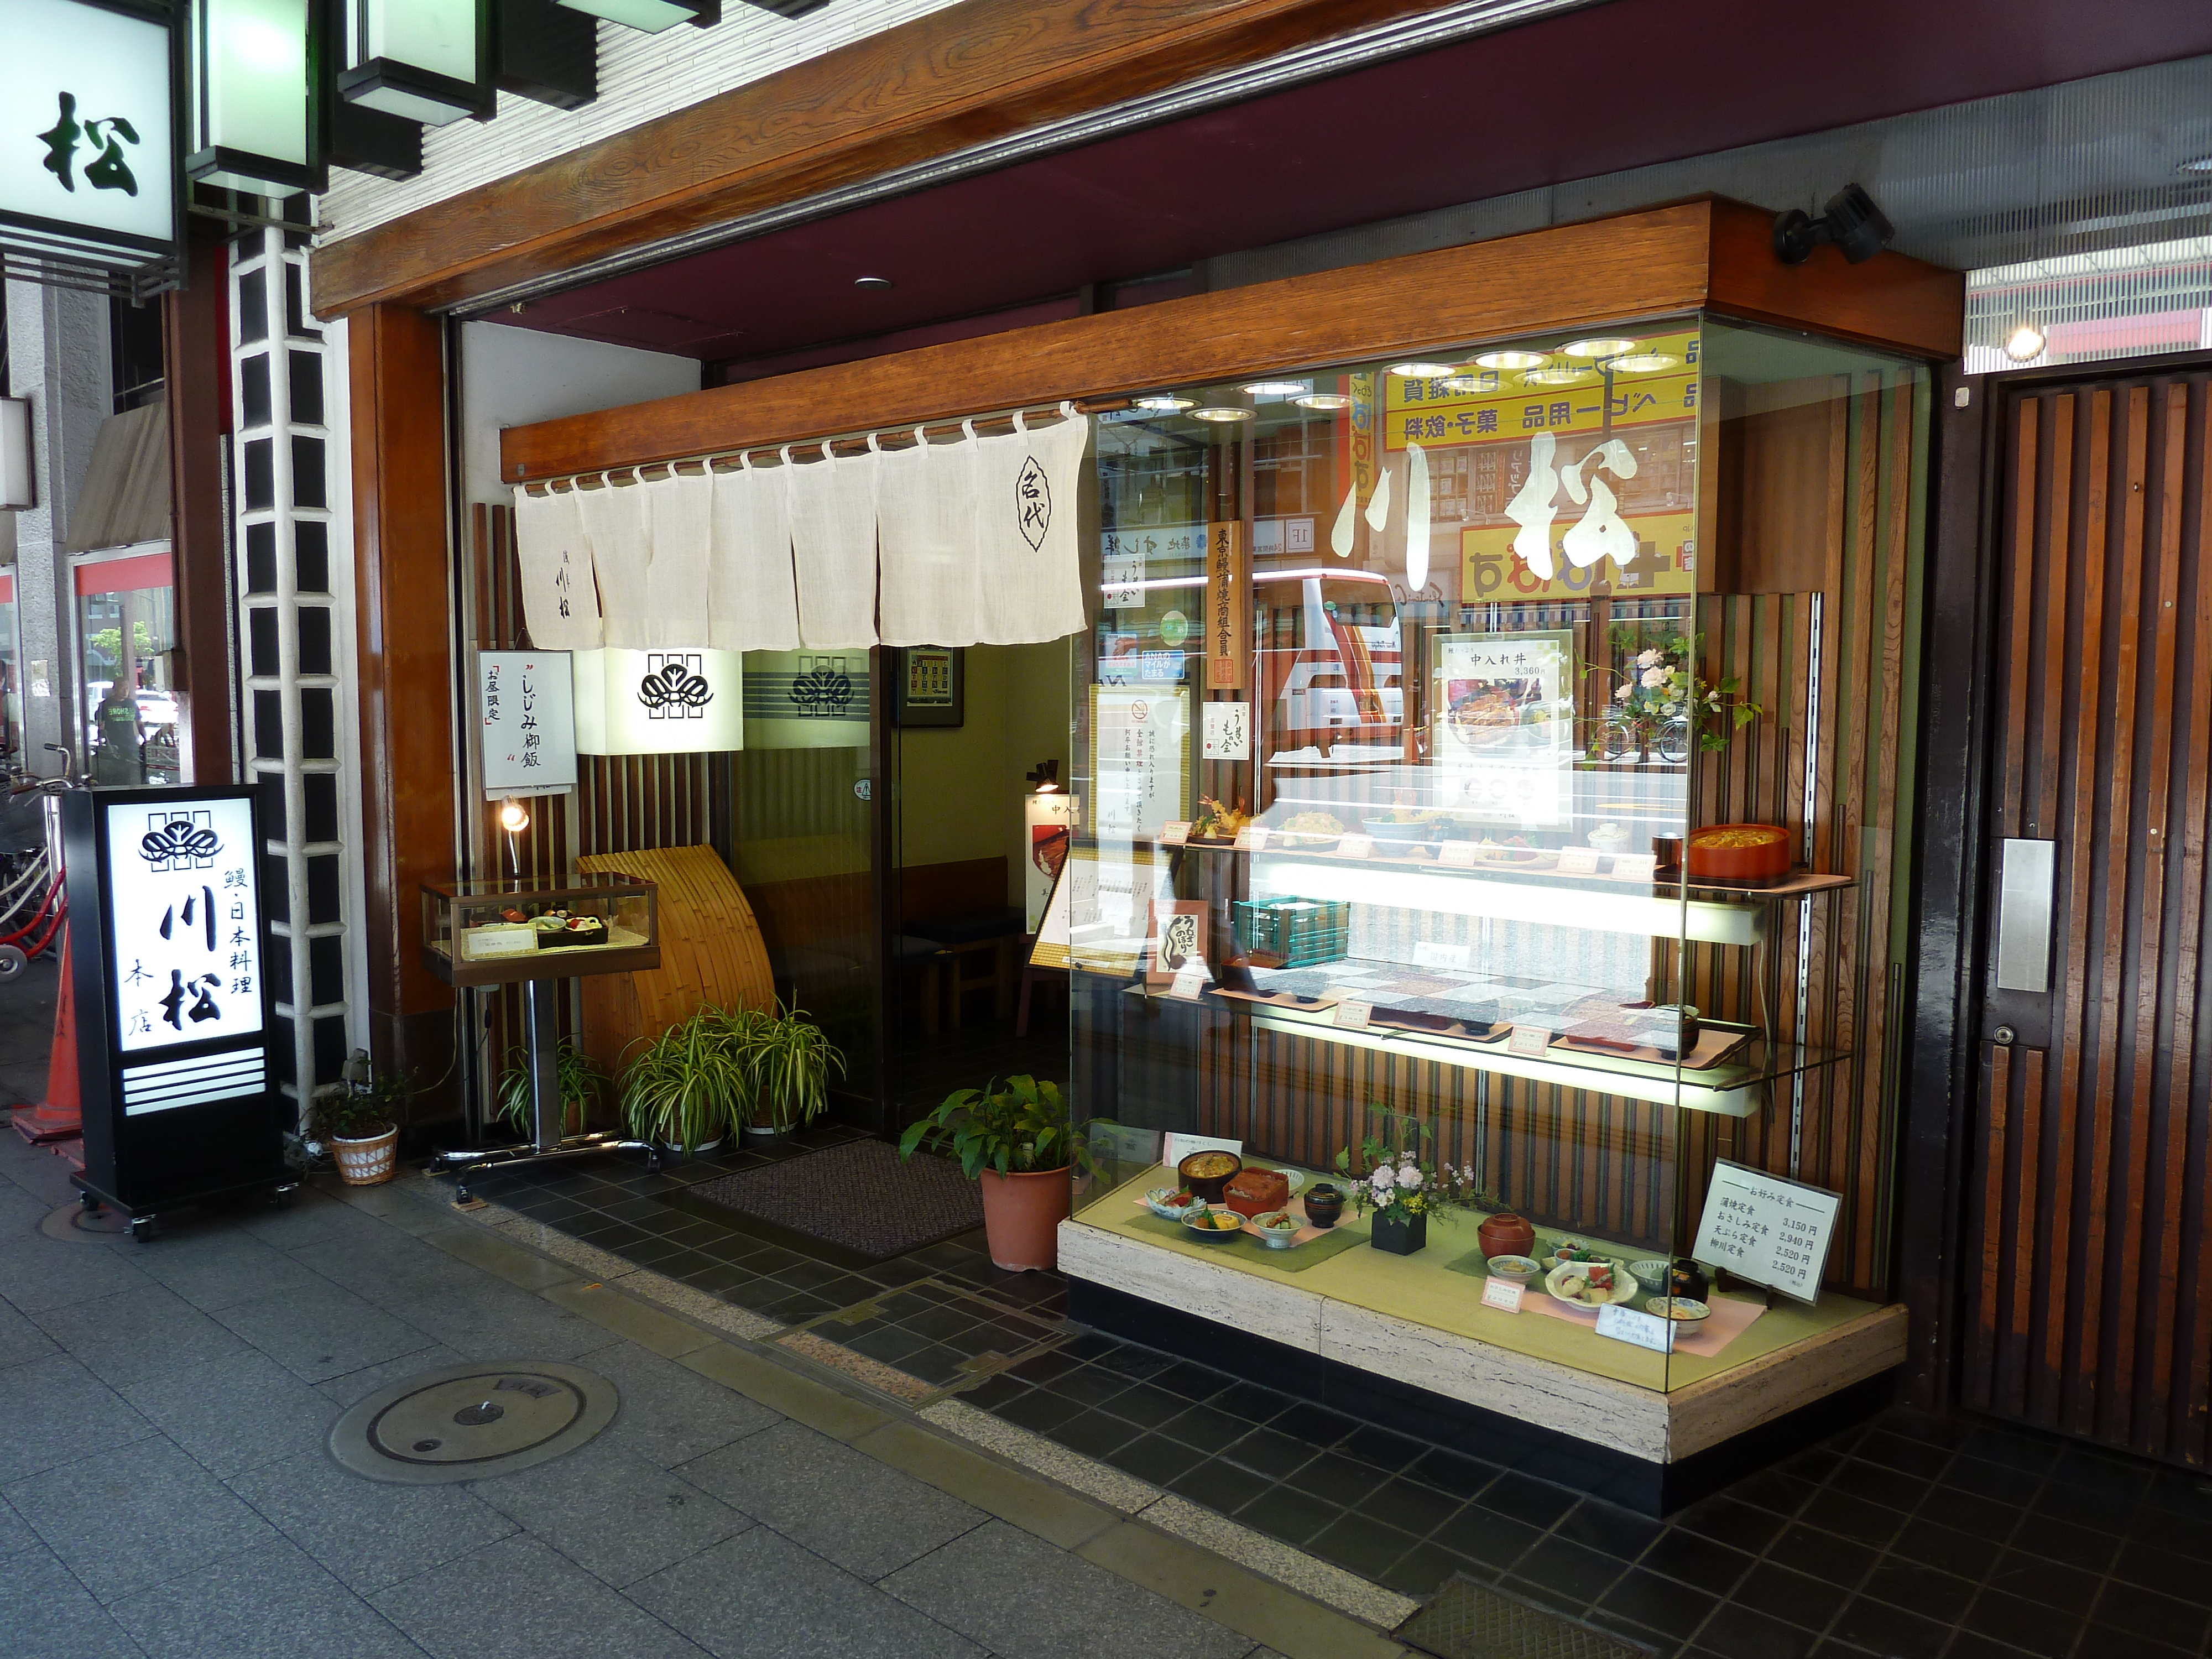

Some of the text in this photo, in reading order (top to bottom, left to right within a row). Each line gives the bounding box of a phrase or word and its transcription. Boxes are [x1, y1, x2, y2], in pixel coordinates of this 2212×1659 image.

[36, 91, 140, 197] 松
[1022, 470, 1045, 528] 名代
[1145, 660, 1170, 669] マイルが
[1145, 669, 1164, 677] たまる
[224, 868, 253, 994] 鰻・日本料理
[158, 885, 221, 1031] 川松
[123, 958, 154, 1036] 本店
[1720, 1197, 1756, 1216] 蒲焼定食
[1750, 1187, 1795, 1208] お好み定食
[1717, 1211, 1770, 1236] おさしみ定食
[1710, 1237, 1745, 1258] 柳川定食
[1713, 1225, 1757, 1247] 天ぷら定食
